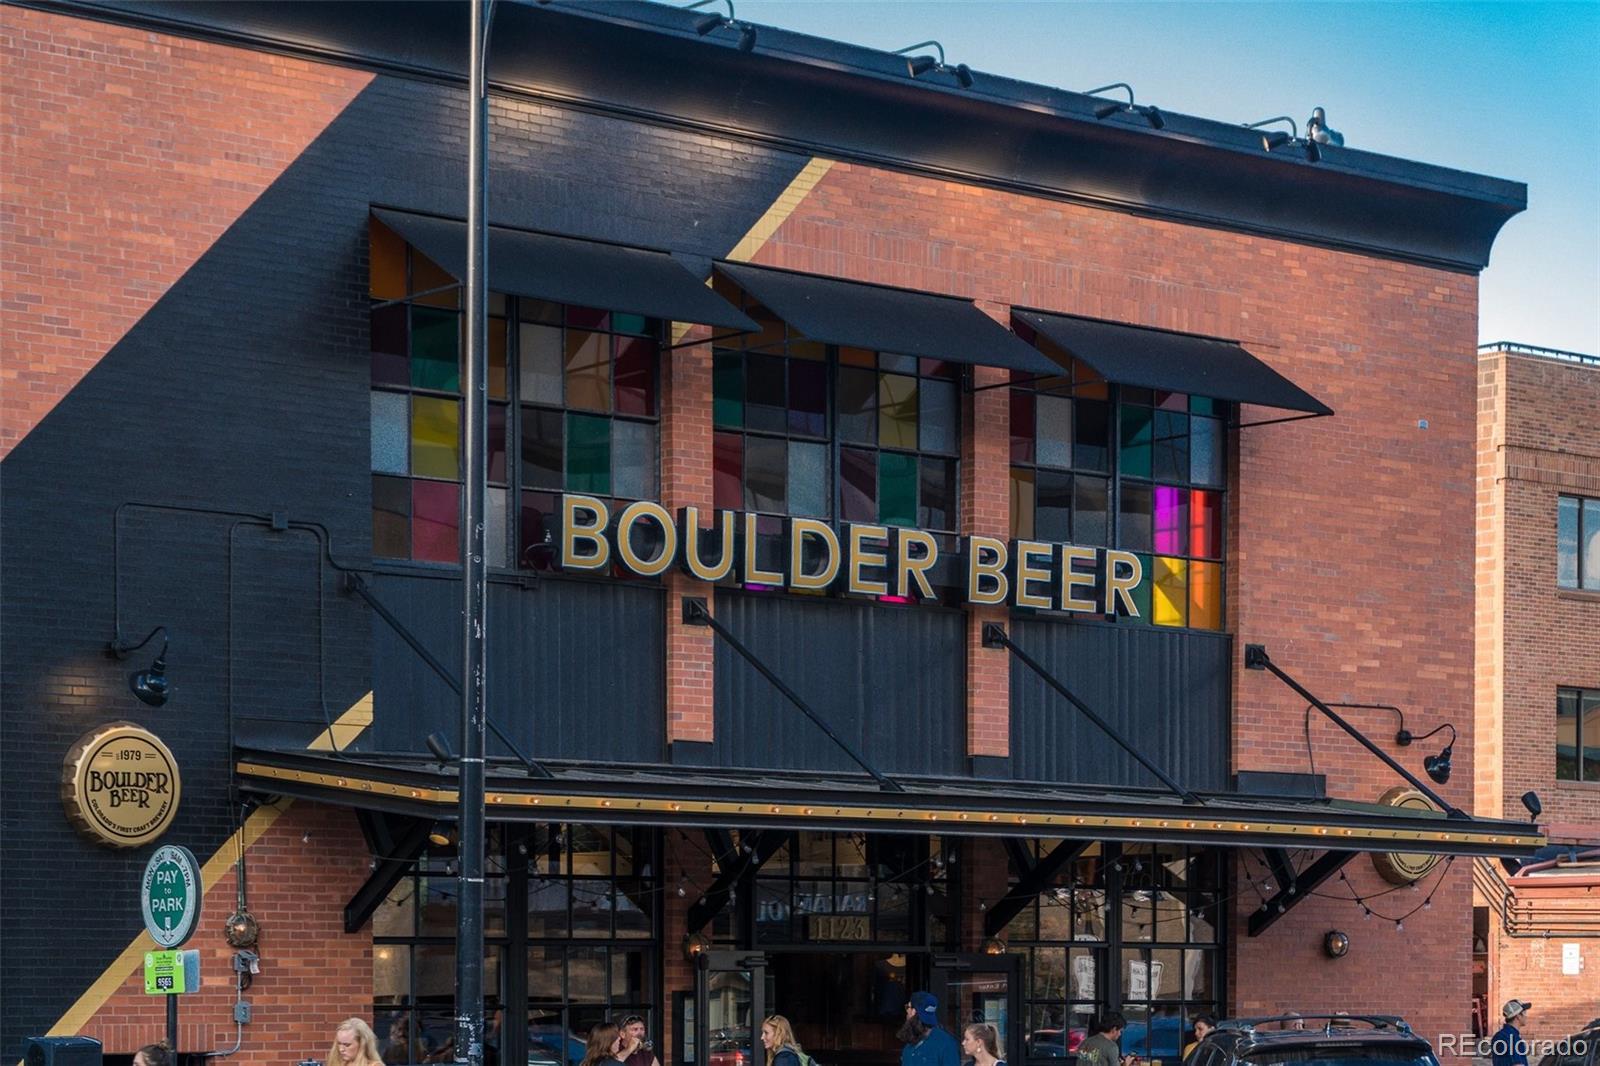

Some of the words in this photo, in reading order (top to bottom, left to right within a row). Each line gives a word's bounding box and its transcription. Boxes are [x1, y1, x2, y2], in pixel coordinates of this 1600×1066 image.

[561, 495, 938, 600] BOULDER
[968, 536, 1143, 618] BEER
[120, 749, 142, 761] 1979
[90, 770, 169, 794] BOULDER
[110, 788, 150, 808] BEER
[132, 822, 151, 833] CRAFT
[150, 800, 168, 826] BREWERY
[156, 869, 179, 885] PAY
[164, 887, 172, 895] to
[151, 896, 184, 913] PARK
[815, 916, 865, 940] 1123
[157, 977, 172, 987] 9565
